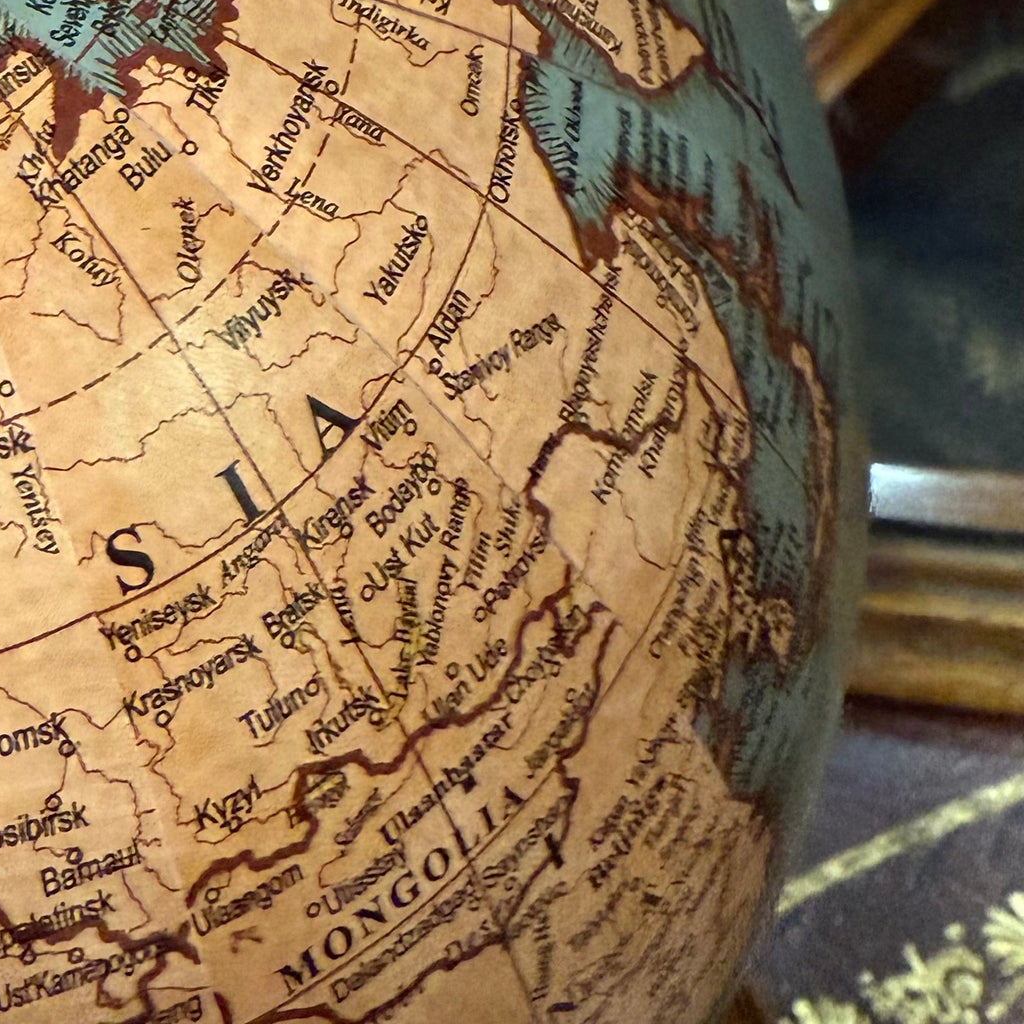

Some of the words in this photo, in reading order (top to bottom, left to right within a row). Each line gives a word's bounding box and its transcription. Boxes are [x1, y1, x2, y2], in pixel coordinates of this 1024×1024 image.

[31, 125, 135, 207] Khatanga
[246, 59, 330, 195] Verkhoyansk
[284, 177, 341, 218] Lena
[272, 783, 525, 998] MONGOLIA
